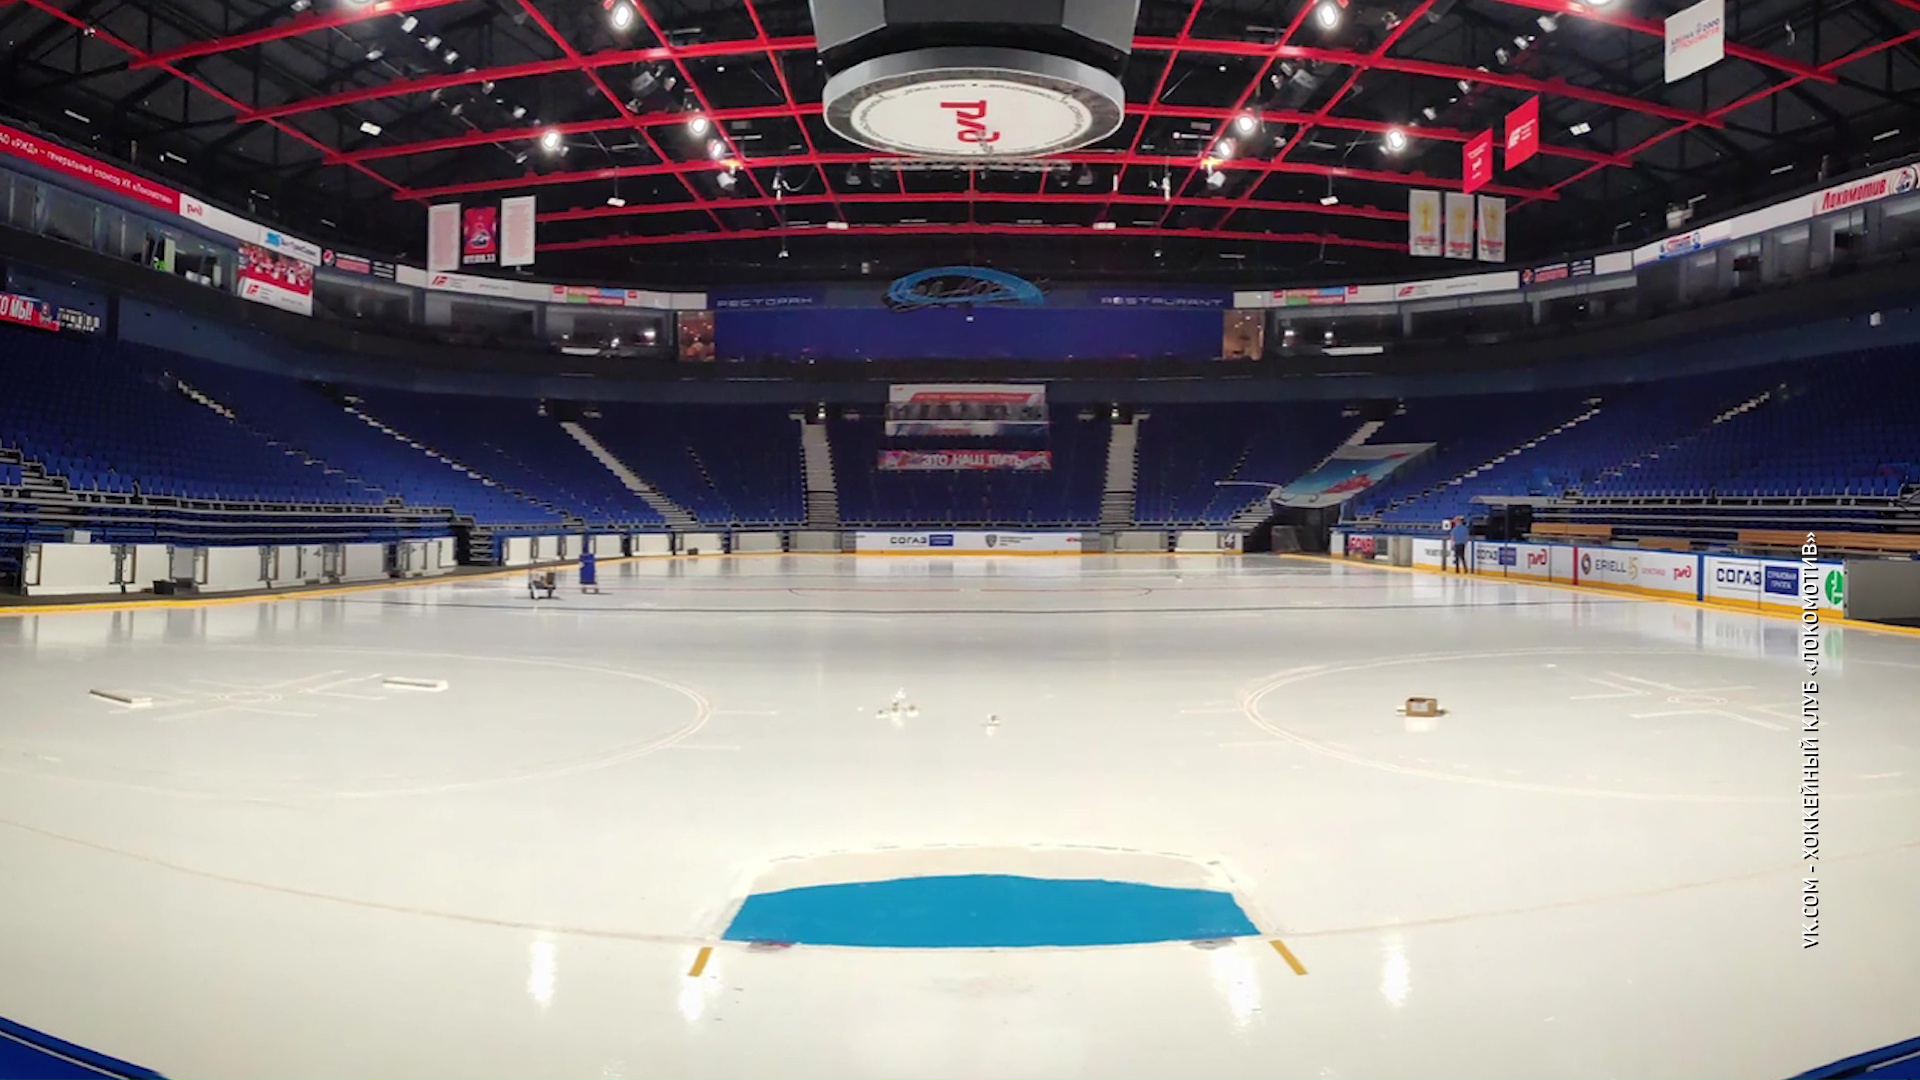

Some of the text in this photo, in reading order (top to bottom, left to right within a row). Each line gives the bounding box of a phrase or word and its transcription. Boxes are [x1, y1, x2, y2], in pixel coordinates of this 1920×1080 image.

[923, 454, 948, 466] ЭТО
[953, 454, 985, 466] НАШ
[890, 536, 927, 544] СОГАЗ
[1595, 559, 1627, 573] ERIELL
[1717, 568, 1762, 586] СОГАЗ
